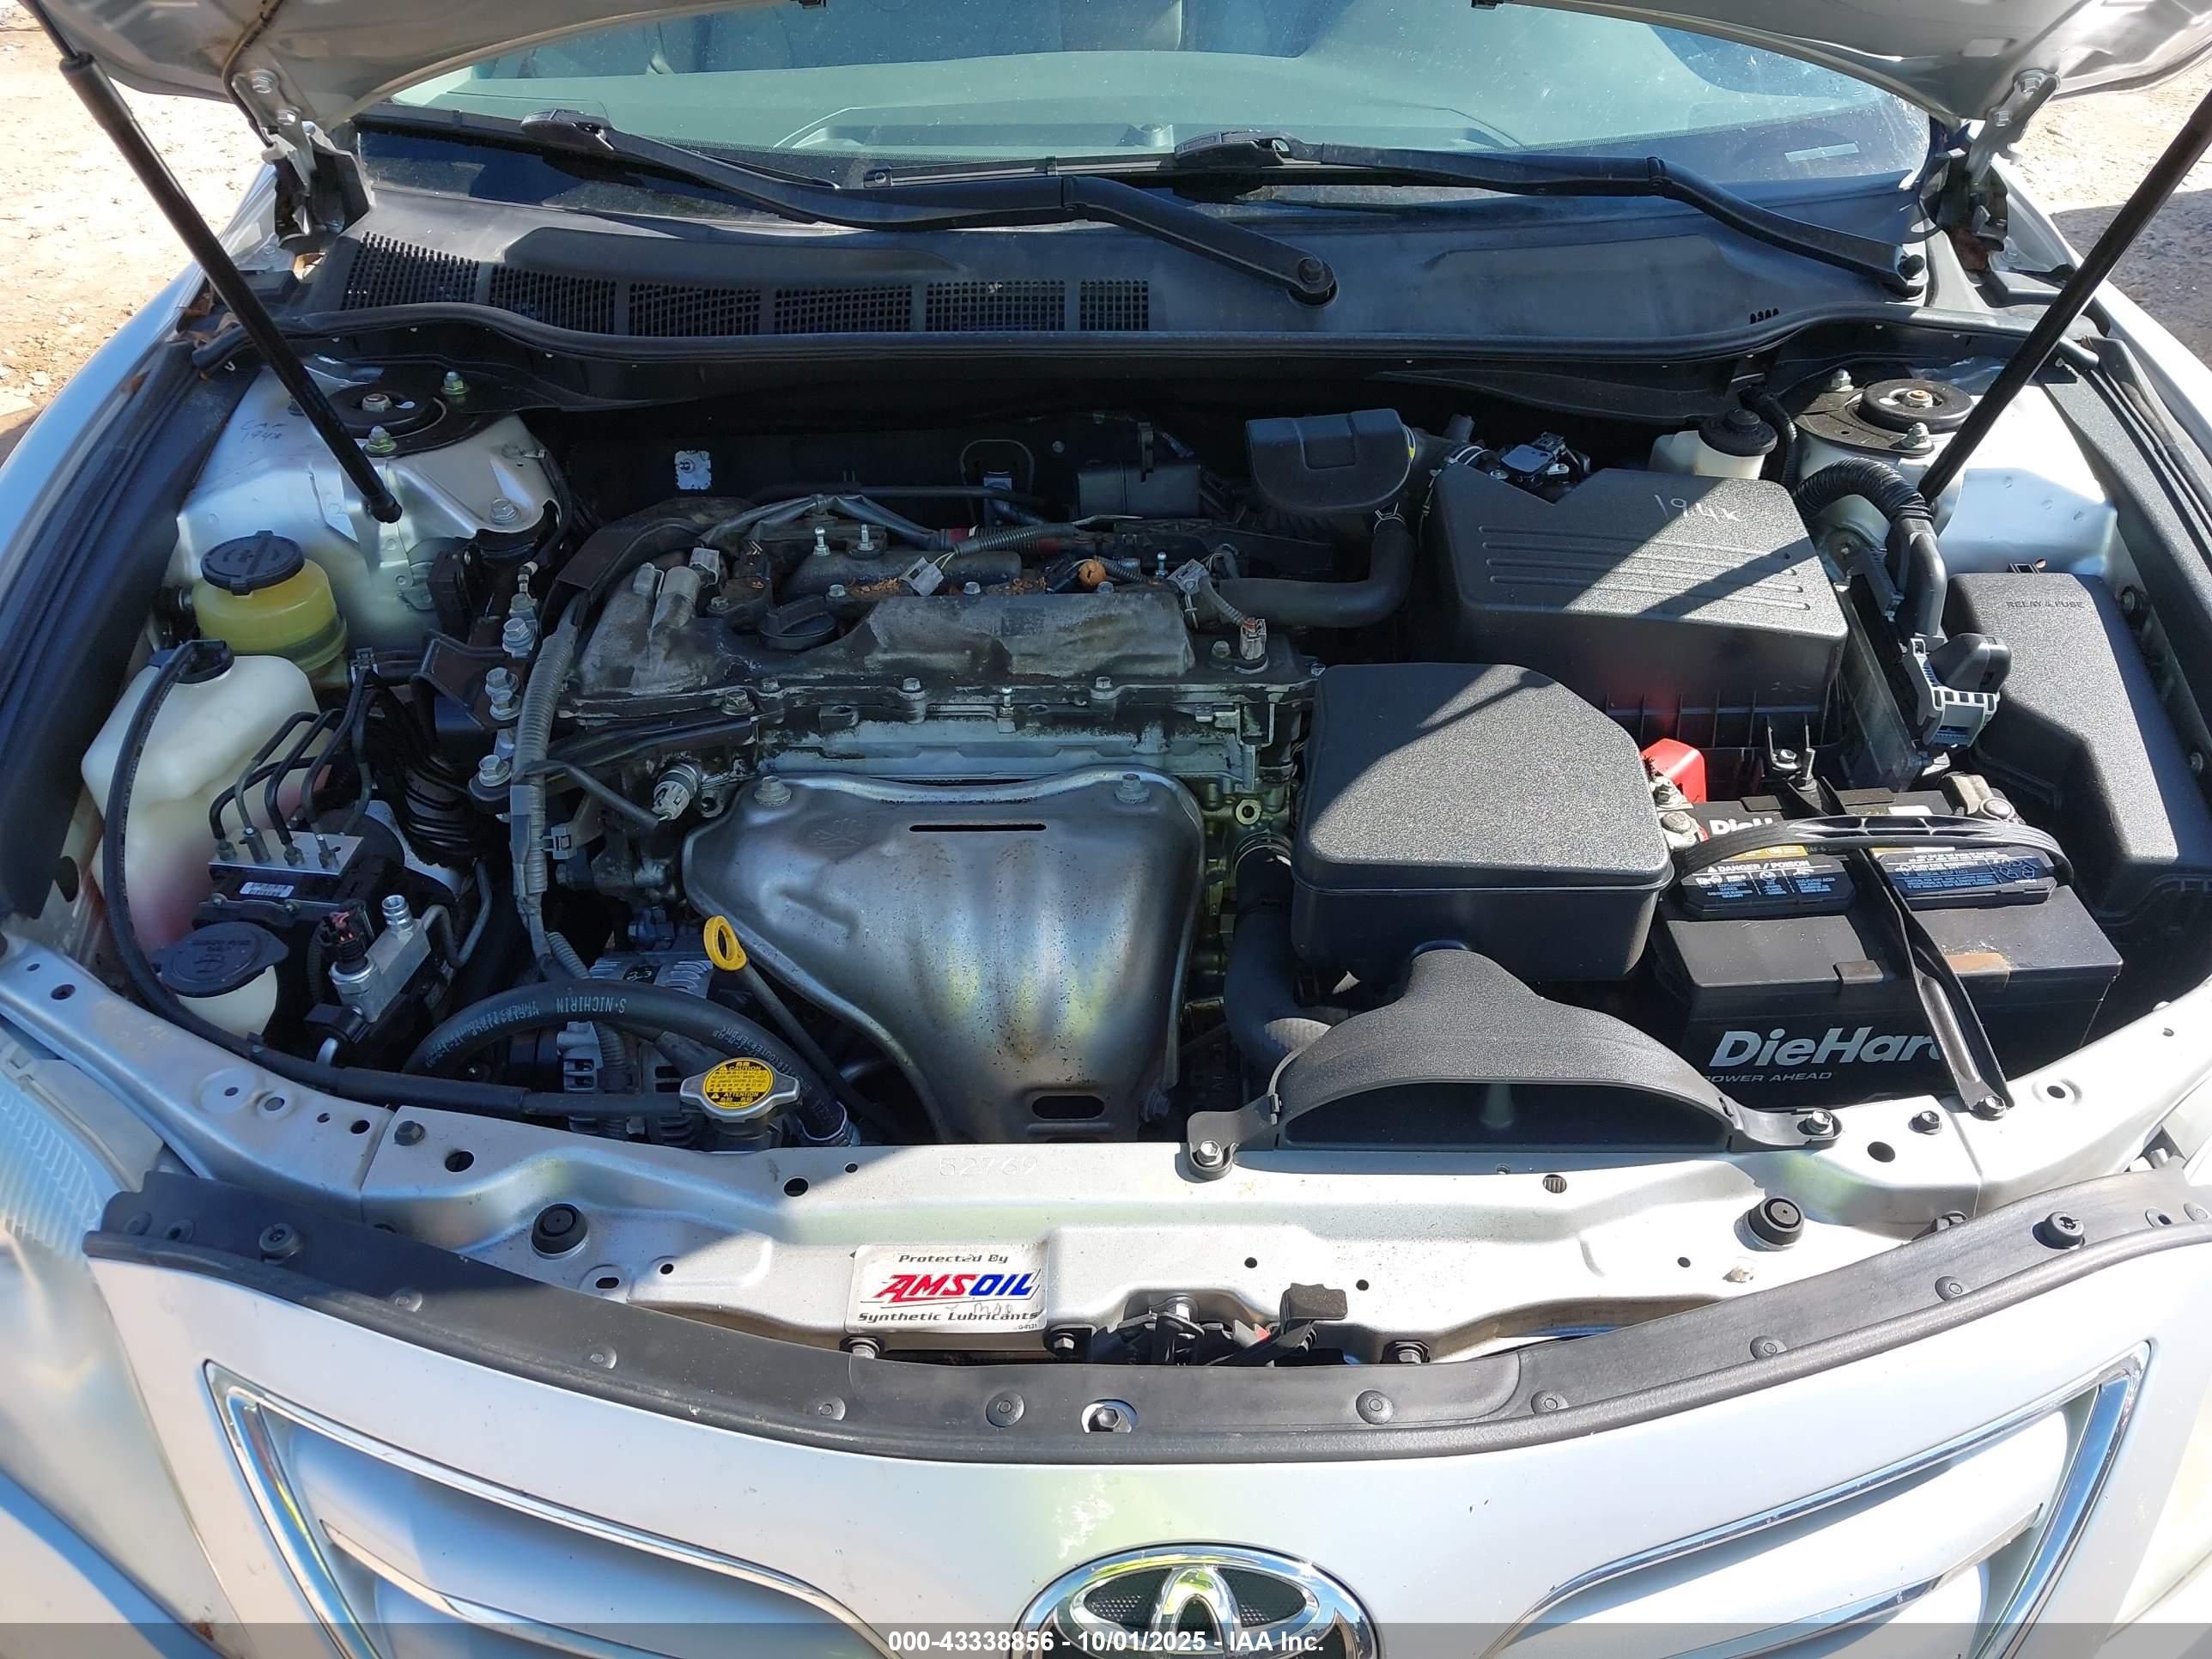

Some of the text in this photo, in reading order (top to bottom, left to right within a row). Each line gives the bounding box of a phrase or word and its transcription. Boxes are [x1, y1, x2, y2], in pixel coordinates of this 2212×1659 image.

[1717, 862, 1761, 873] DANGER
[1770, 860, 1811, 869] POISON
[1709, 1025, 1941, 1066] DieHar
[1769, 1072, 1832, 1082] AHEAD
[898, 1254, 1009, 1264] Protected By
[872, 1273, 1035, 1304] AMSOIL
[858, 1311, 1040, 1323] Synthetic Lubricants
